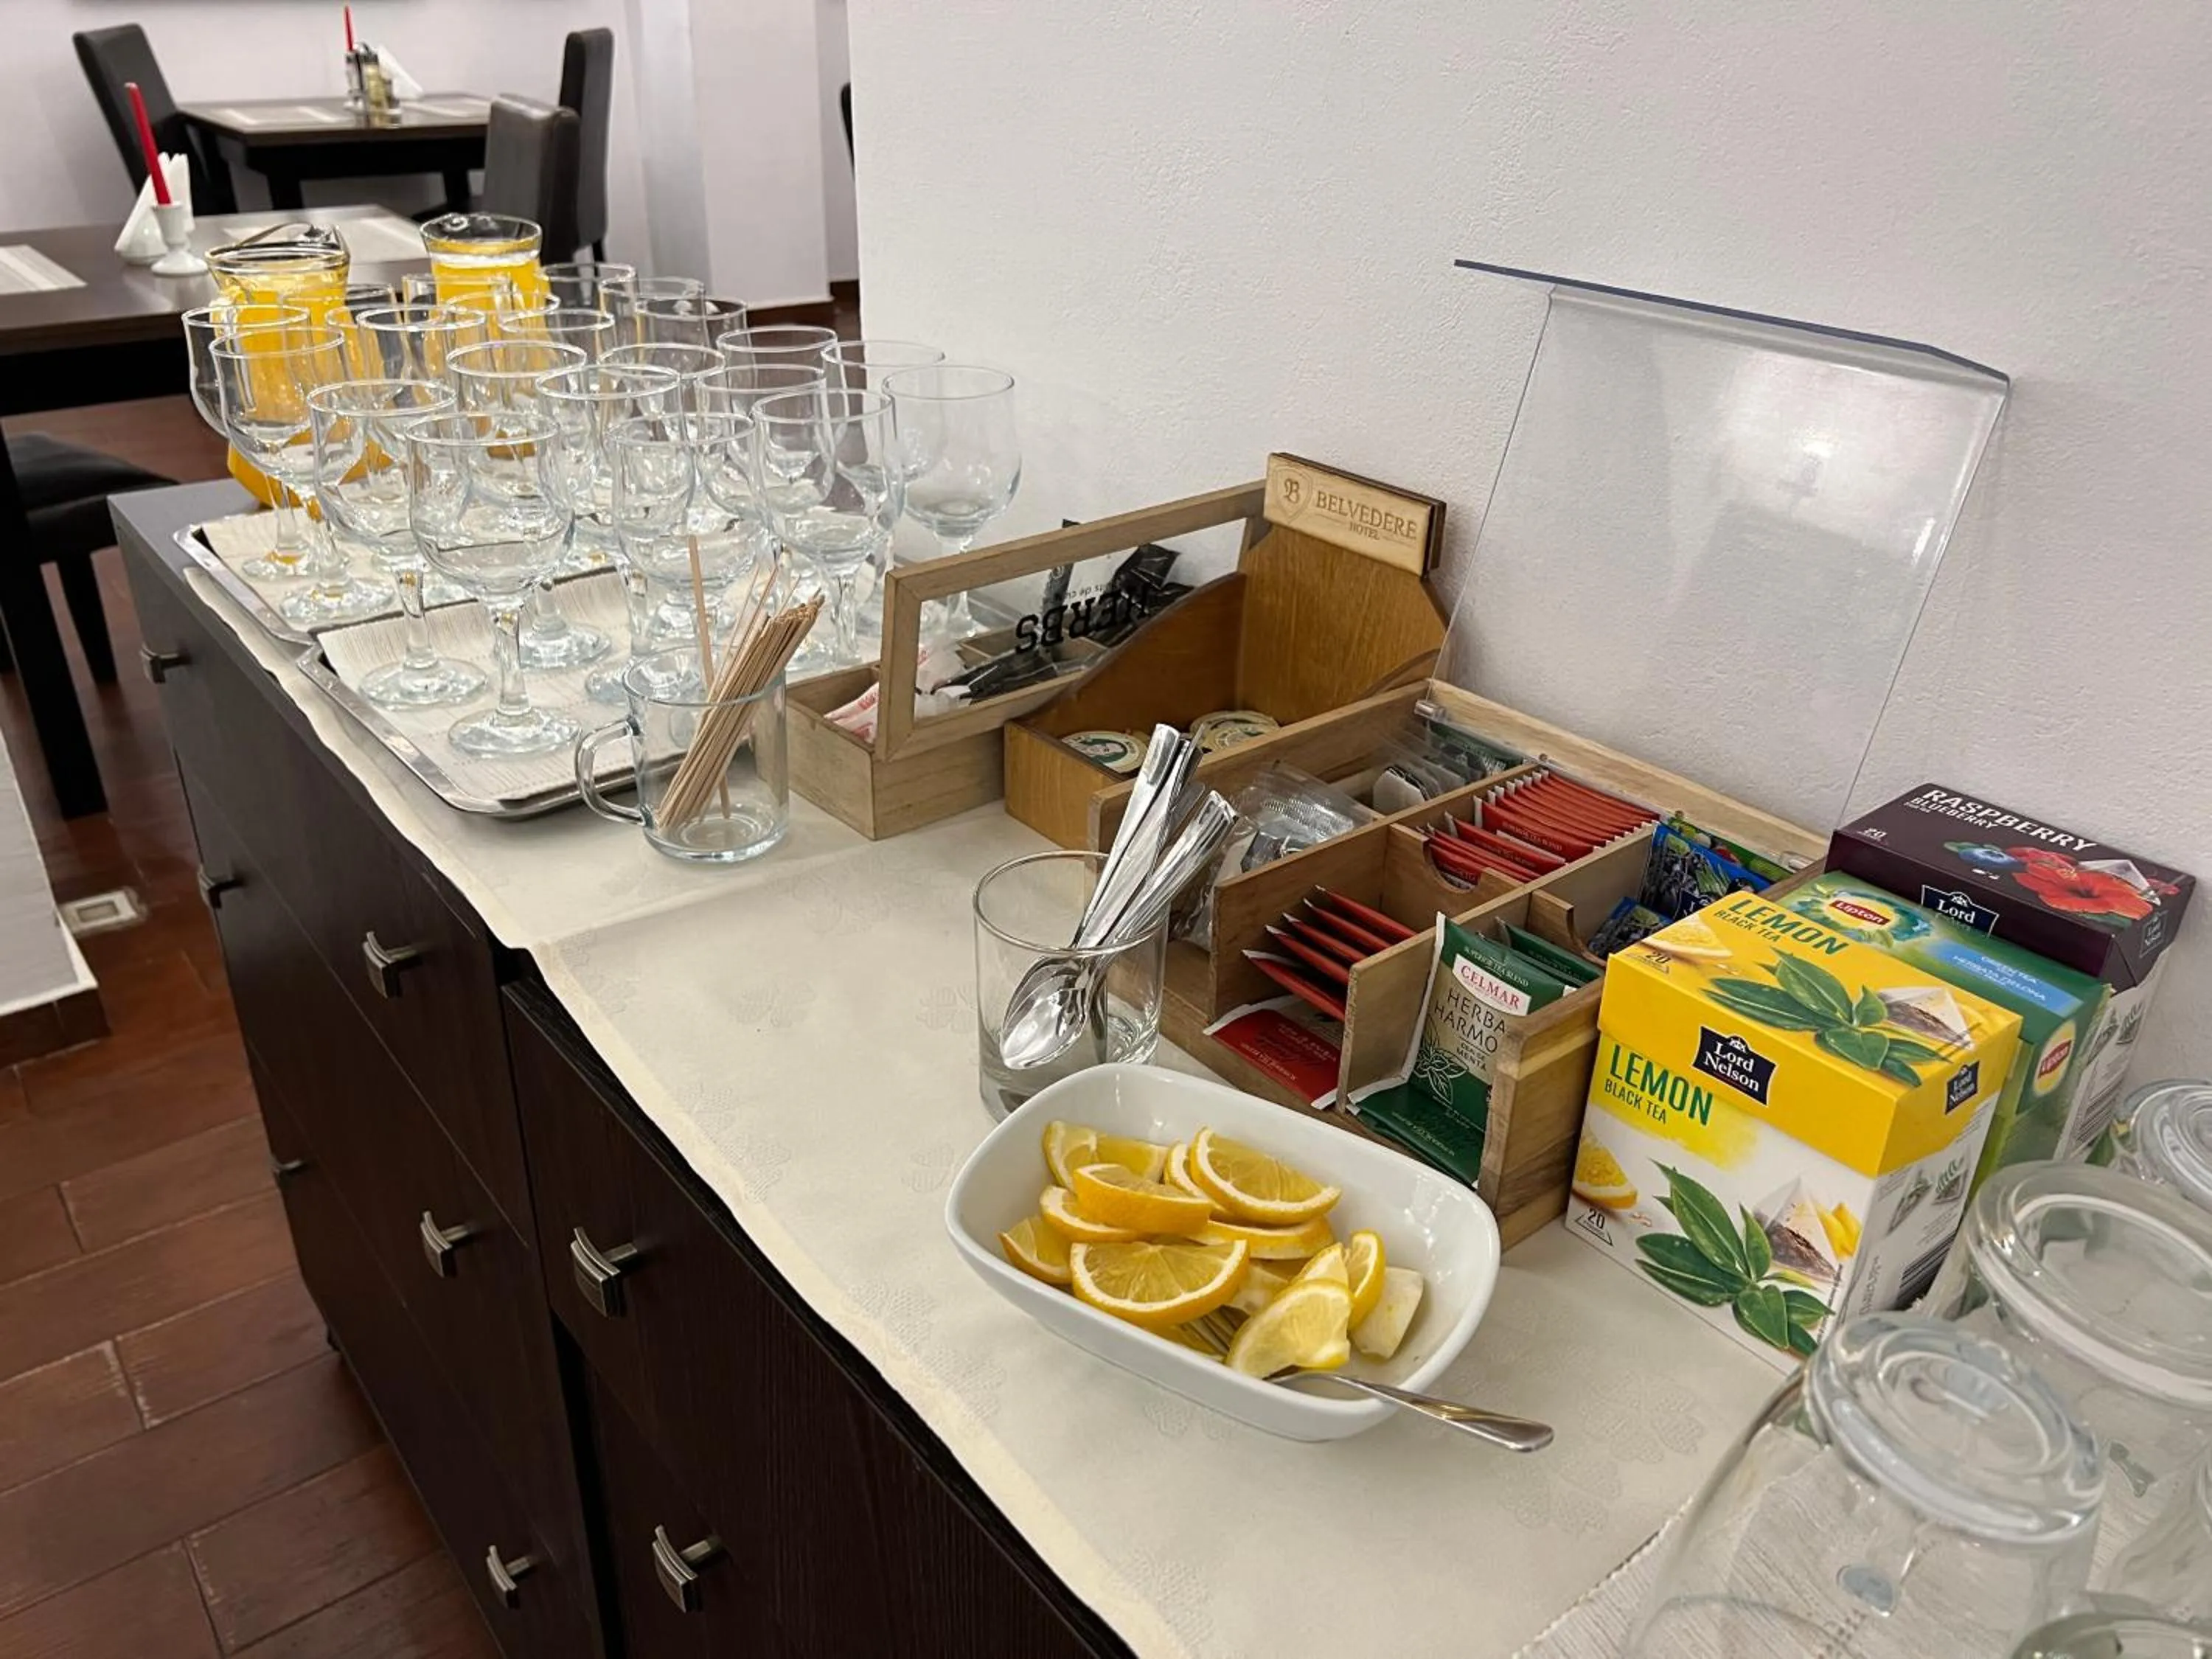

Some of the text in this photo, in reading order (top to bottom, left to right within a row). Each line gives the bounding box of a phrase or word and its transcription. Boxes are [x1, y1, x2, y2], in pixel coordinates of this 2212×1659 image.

[1315, 490, 1417, 540] BELVEDERE
[1349, 521, 1380, 540] HOTEL
[1864, 827, 1887, 839] 20
[1910, 797, 1998, 829] BLUEBERRY
[1922, 790, 2097, 852] RASPBERRY
[1714, 909, 1782, 943] BLACK TEA
[1728, 899, 1850, 956] LEMON
[1836, 902, 1884, 923] Lipton
[1937, 899, 1976, 924] Lord
[1460, 964, 1521, 1010] CELMAR
[1434, 1004, 1498, 1054] HARMO
[1447, 988, 1506, 1034] HERBA
[1703, 1051, 1760, 1092] Nelson
[1714, 1041, 1755, 1073] Lord
[1604, 1078, 1666, 1124] BLACK TEA
[1610, 1044, 1714, 1127] LEMON
[1587, 1208, 1605, 1229] 20
